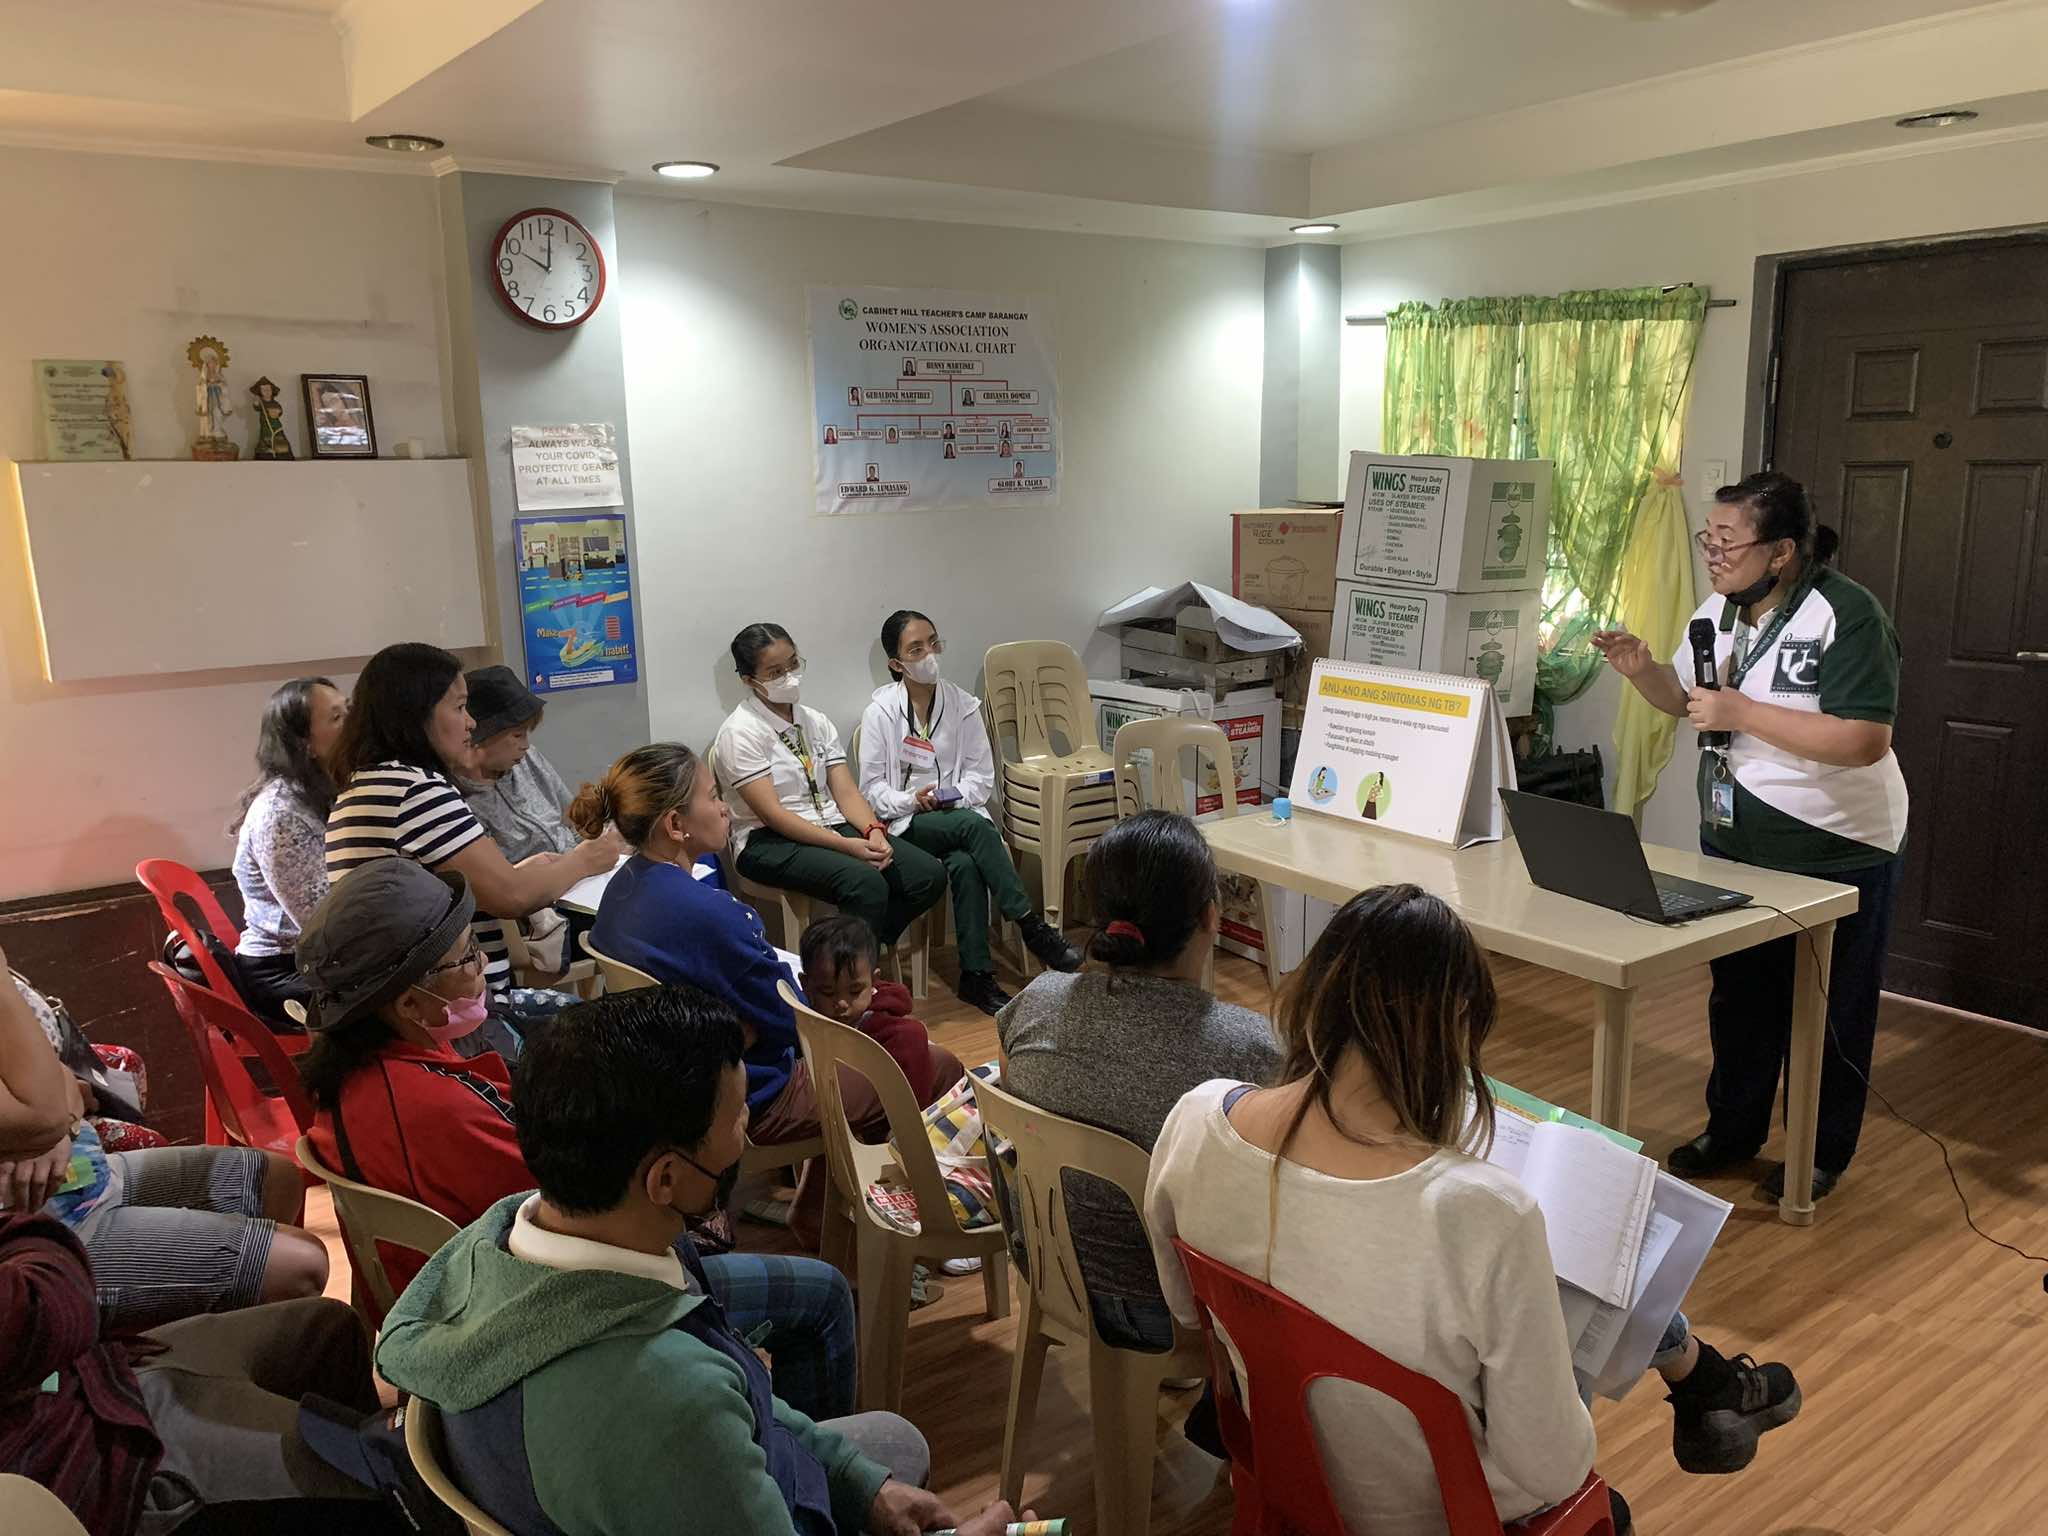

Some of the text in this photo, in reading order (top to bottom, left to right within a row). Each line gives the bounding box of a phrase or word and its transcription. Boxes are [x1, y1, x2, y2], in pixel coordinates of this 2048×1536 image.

[521, 223, 532, 240] 11
[538, 218, 554, 236] 12
[506, 238, 521, 255] 10
[576, 242, 587, 261] 2
[500, 258, 513, 276] 9
[582, 265, 593, 282] 3
[508, 281, 519, 298] 8
[577, 287, 590, 303] 4
[523, 297, 535, 314] 7
[543, 305, 556, 322] 6
[564, 301, 575, 318] 5
[863, 306, 1028, 320] CABINET HILL TEACHER'S CAMP BARANGAY
[866, 321, 1009, 337] WOMEN'S ASSOCIATION
[859, 339, 1016, 354] ORGANIZATIONAL CHART
[529, 439, 600, 448] ALWAYS WEAR
[536, 451, 596, 460] YOUR COVID
[519, 463, 616, 473] PROTECTIVE GEARS
[536, 475, 601, 485] AT ALL TIMES
[1372, 472, 1407, 492] WINGS
[1410, 475, 1443, 484] Heavy Duty
[1408, 485, 1441, 494] STEAMER
[1252, 529, 1273, 538] RICE
[1360, 563, 1433, 579] Durable Elegant Style
[1355, 597, 1386, 619] WINGS
[1390, 603, 1421, 614] Heavy Duty
[1388, 612, 1419, 624] STEAMER
[1780, 648, 1818, 685] UC
[1322, 681, 1462, 712] ANU-ANO ANG SINTOMAS NG TB?
[1230, 725, 1260, 736] STEAMER
